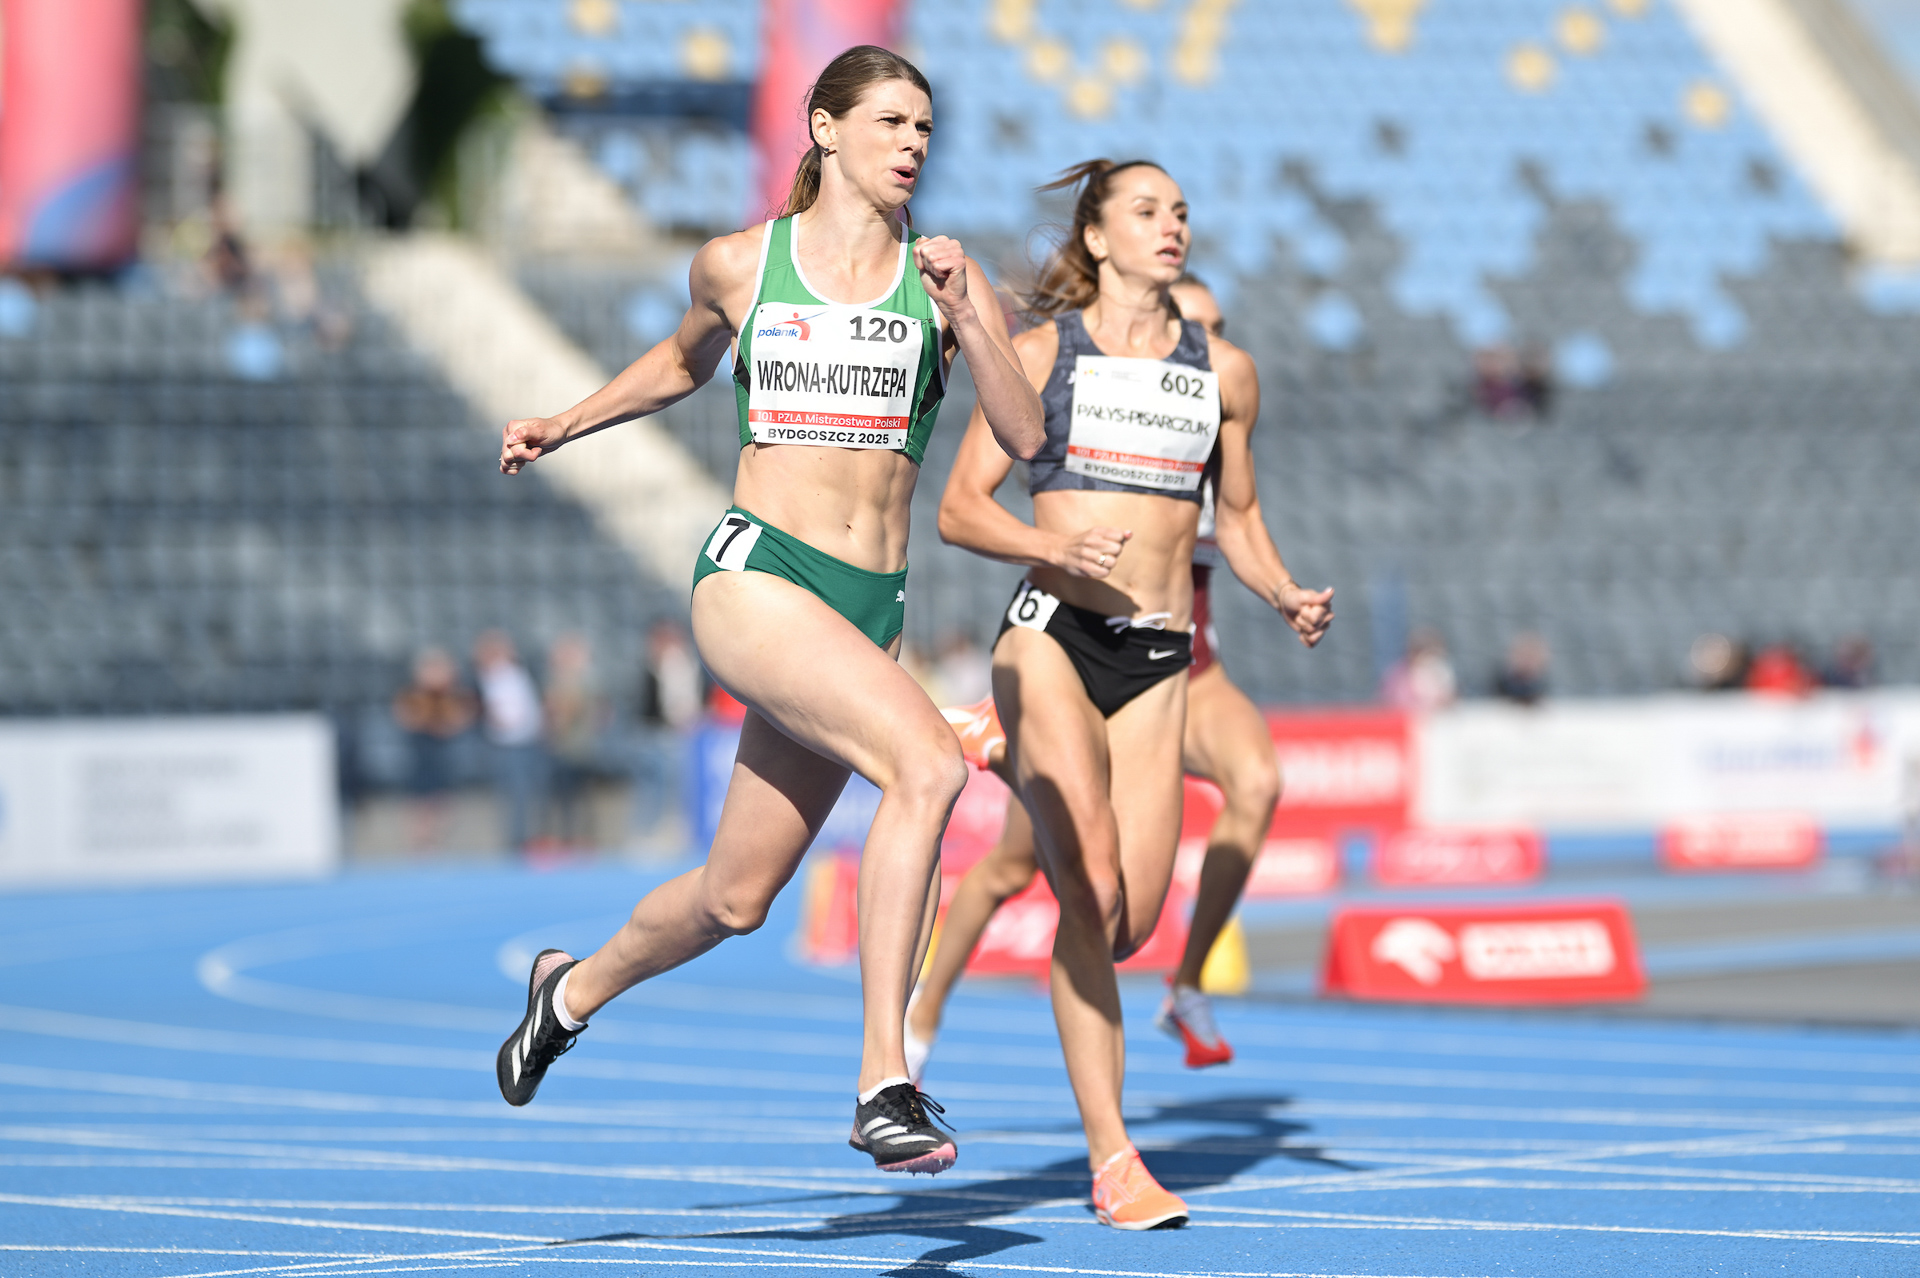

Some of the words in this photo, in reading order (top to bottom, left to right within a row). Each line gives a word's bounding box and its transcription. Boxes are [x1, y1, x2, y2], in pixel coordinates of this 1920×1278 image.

[757, 327, 798, 338] polanik
[850, 316, 907, 343] 120
[757, 360, 907, 398] WRONA-KUTRZEPA
[1161, 371, 1205, 399] 602
[757, 411, 776, 422] 101.
[778, 413, 802, 423] PZLA
[805, 414, 872, 428] Mistrzostwa
[874, 418, 901, 428] Polski
[1077, 403, 1211, 436] PAŁYS-PISARCZUK
[767, 428, 856, 443] BYDGOSZCZ
[858, 433, 889, 444] 2025
[1094, 449, 1118, 461] PZLA
[1084, 463, 1161, 483] BYDGOSZCZ
[715, 517, 751, 562] 7
[1019, 586, 1042, 621] 6
